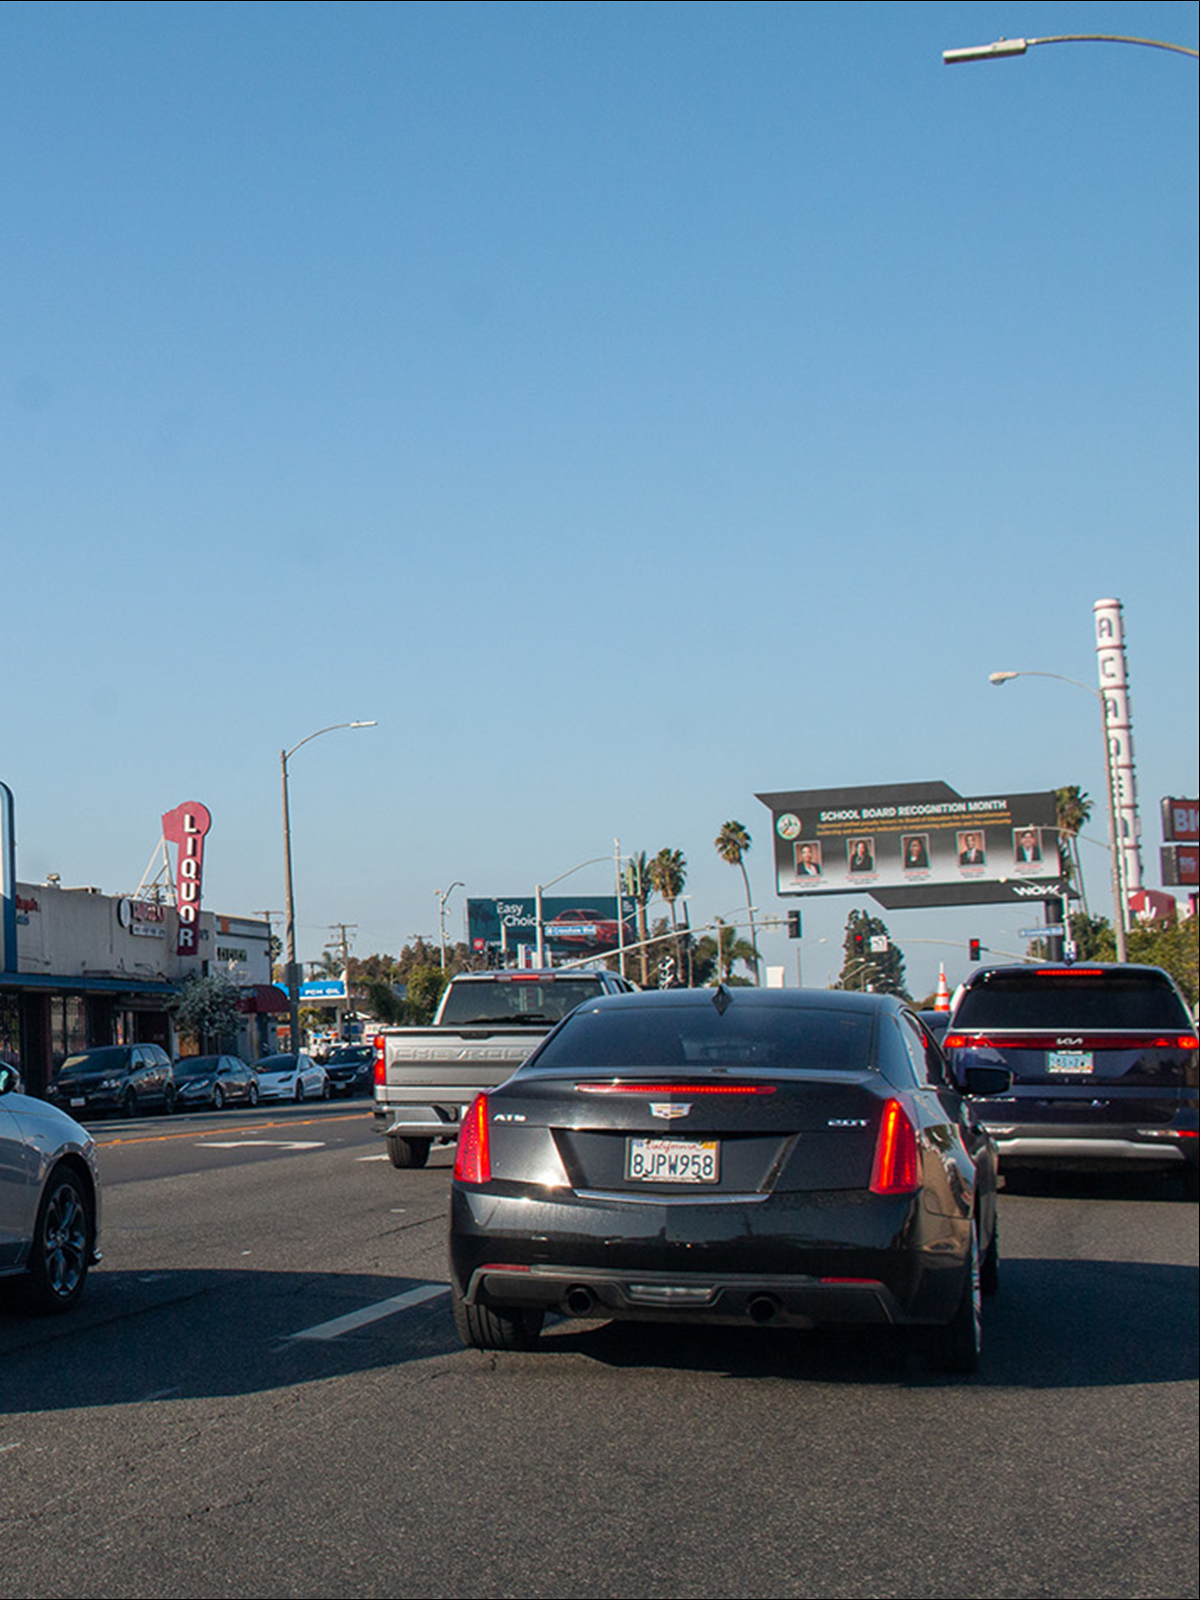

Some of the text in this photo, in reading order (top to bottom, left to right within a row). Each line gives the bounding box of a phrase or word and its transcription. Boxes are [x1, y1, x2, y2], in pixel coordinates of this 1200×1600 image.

[820, 811, 860, 822] SCHOOL
[861, 807, 897, 819] BOARD
[897, 803, 966, 816] RECOGNITION
[967, 800, 1007, 812] MONTH
[180, 814, 197, 947] LIQUOR
[497, 902, 524, 917] Easy
[492, 1112, 527, 1123] ATS
[644, 1140, 704, 1154] California
[632, 1152, 714, 1177] 8JPW958
